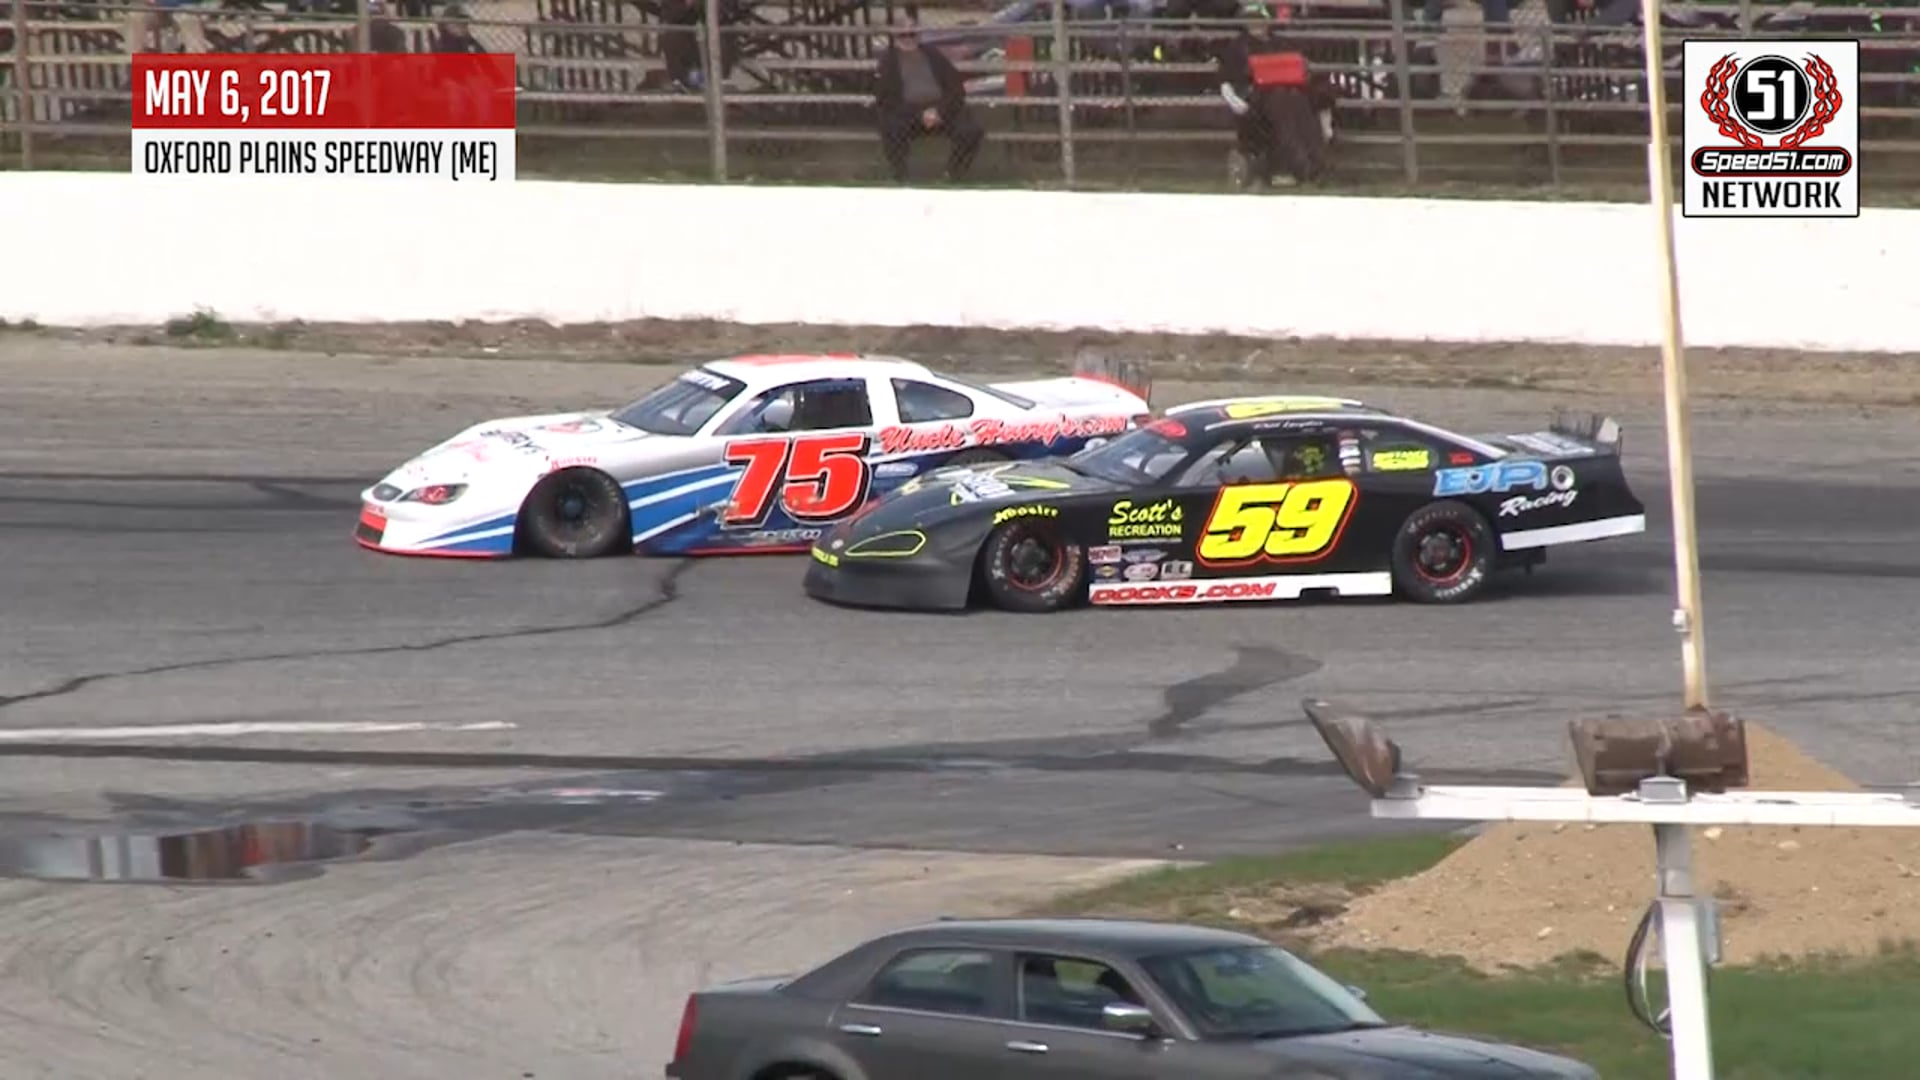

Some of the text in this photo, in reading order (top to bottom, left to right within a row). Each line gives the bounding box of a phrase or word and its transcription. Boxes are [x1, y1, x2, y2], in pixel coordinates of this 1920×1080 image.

[878, 423, 964, 454] Uncle
[723, 432, 868, 524] 75
[1108, 499, 1183, 524] Scott's
[1499, 488, 1579, 517] Racing
[1108, 524, 1182, 537] RECREATION
[1197, 478, 1356, 564] 59
